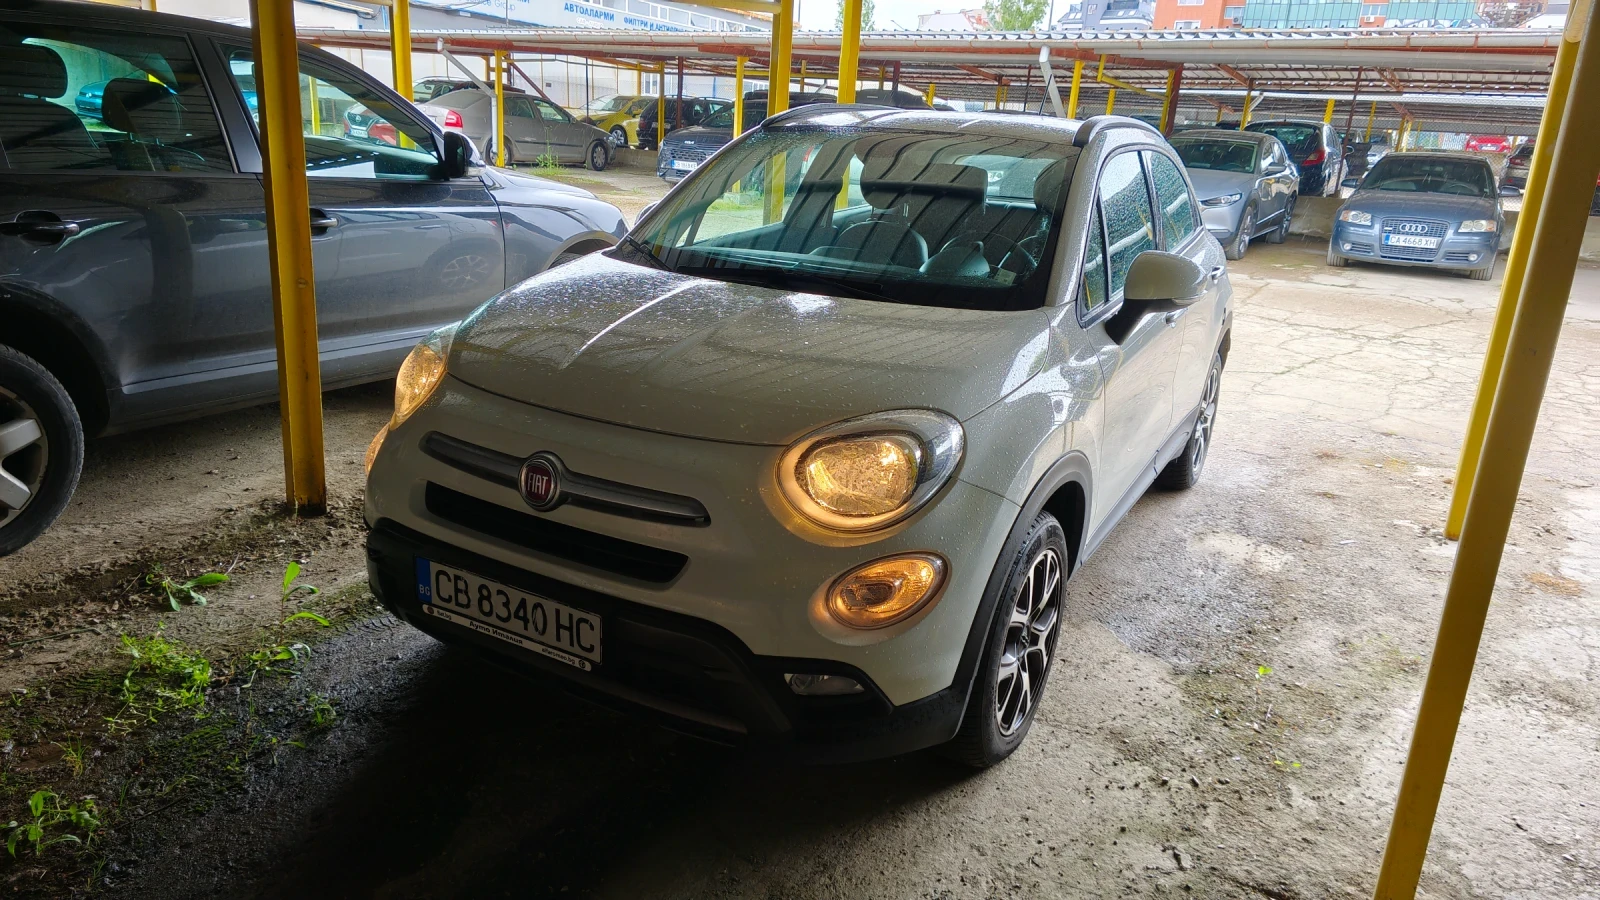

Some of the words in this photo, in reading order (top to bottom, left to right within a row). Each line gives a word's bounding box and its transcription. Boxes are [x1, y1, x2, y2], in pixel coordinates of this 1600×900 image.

[564, 2, 615, 22] АВТОАЛАРМИ
[624, 16, 648, 28] ФИЛТРИ
[1402, 237, 1423, 246] 4668
[1424, 238, 1436, 247] XH
[527, 473, 548, 495] FIAT
[419, 583, 431, 596] BG
[435, 570, 471, 610] CB
[477, 583, 548, 637] 8340
[554, 607, 595, 654] HC
